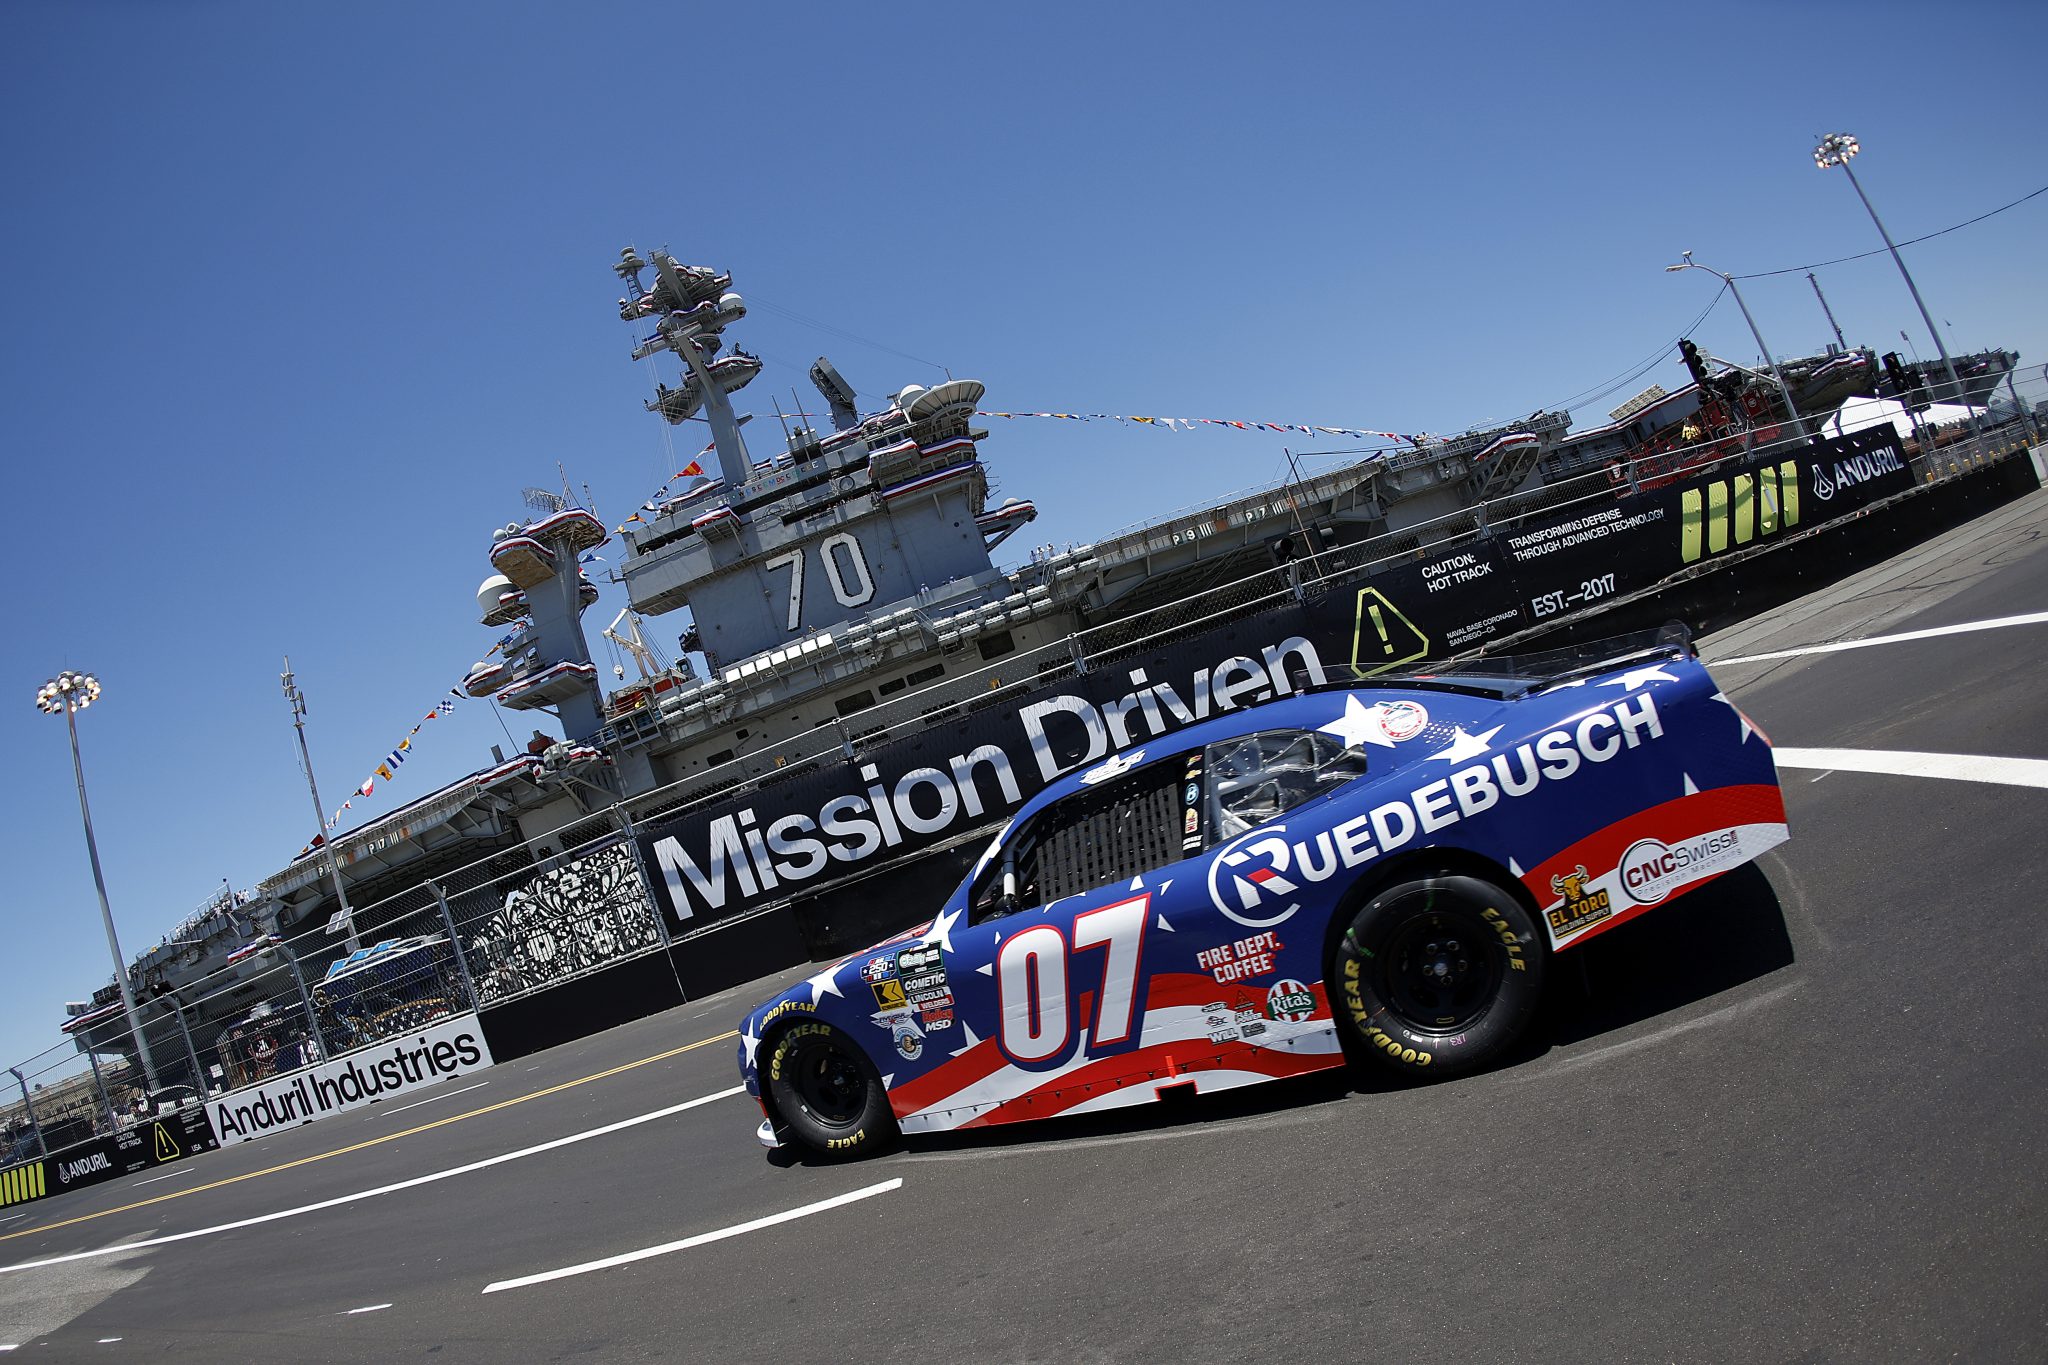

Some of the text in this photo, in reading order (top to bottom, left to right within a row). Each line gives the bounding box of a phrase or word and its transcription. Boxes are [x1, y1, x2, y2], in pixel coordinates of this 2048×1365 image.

[1834, 445, 1904, 490] ANDURIL
[1186, 529, 1196, 540] 9
[1508, 508, 1622, 550] TRANSFORMING DEFENSE
[1513, 508, 1665, 562] THROUGH ADVANCED TECHNOLOGY
[1421, 553, 1477, 579] CAUTION:
[1427, 562, 1493, 593] HOT TRACK
[765, 532, 877, 632] 70
[1446, 609, 1518, 640] NAVAL BASE CORONADO
[1449, 636, 1464, 647] SAN
[652, 636, 1327, 920] Mission Driven
[1223, 692, 1665, 909] RUEDEBUSCH
[1636, 848, 1743, 896] Precision Machining
[1550, 892, 1609, 927] EL TORO
[1554, 908, 1611, 936] BUILDING SUPPLY
[1196, 931, 1280, 969] FIRE DEPT.
[1480, 907, 1526, 972] EAGLE
[869, 962, 888, 974] 250
[905, 972, 945, 990] COMETIC
[999, 892, 1152, 1062] 07
[1213, 954, 1272, 983] COFFEE
[911, 989, 944, 1004] LINCOLN
[921, 998, 950, 1009] WELDERS
[1271, 991, 1312, 1014] Rita's
[759, 999, 816, 1031] GOODYEAR
[926, 1020, 951, 1032] MSD
[1344, 959, 1432, 1066] GOODYEAR
[771, 1024, 831, 1081] GOODYEAR
[218, 1033, 481, 1140] Anduril Industries
[119, 1137, 142, 1151] HOT TRACK
[191, 1143, 202, 1152] USA
[827, 1128, 866, 1149] EAGLE
[69, 1152, 112, 1179] ANDURIL
